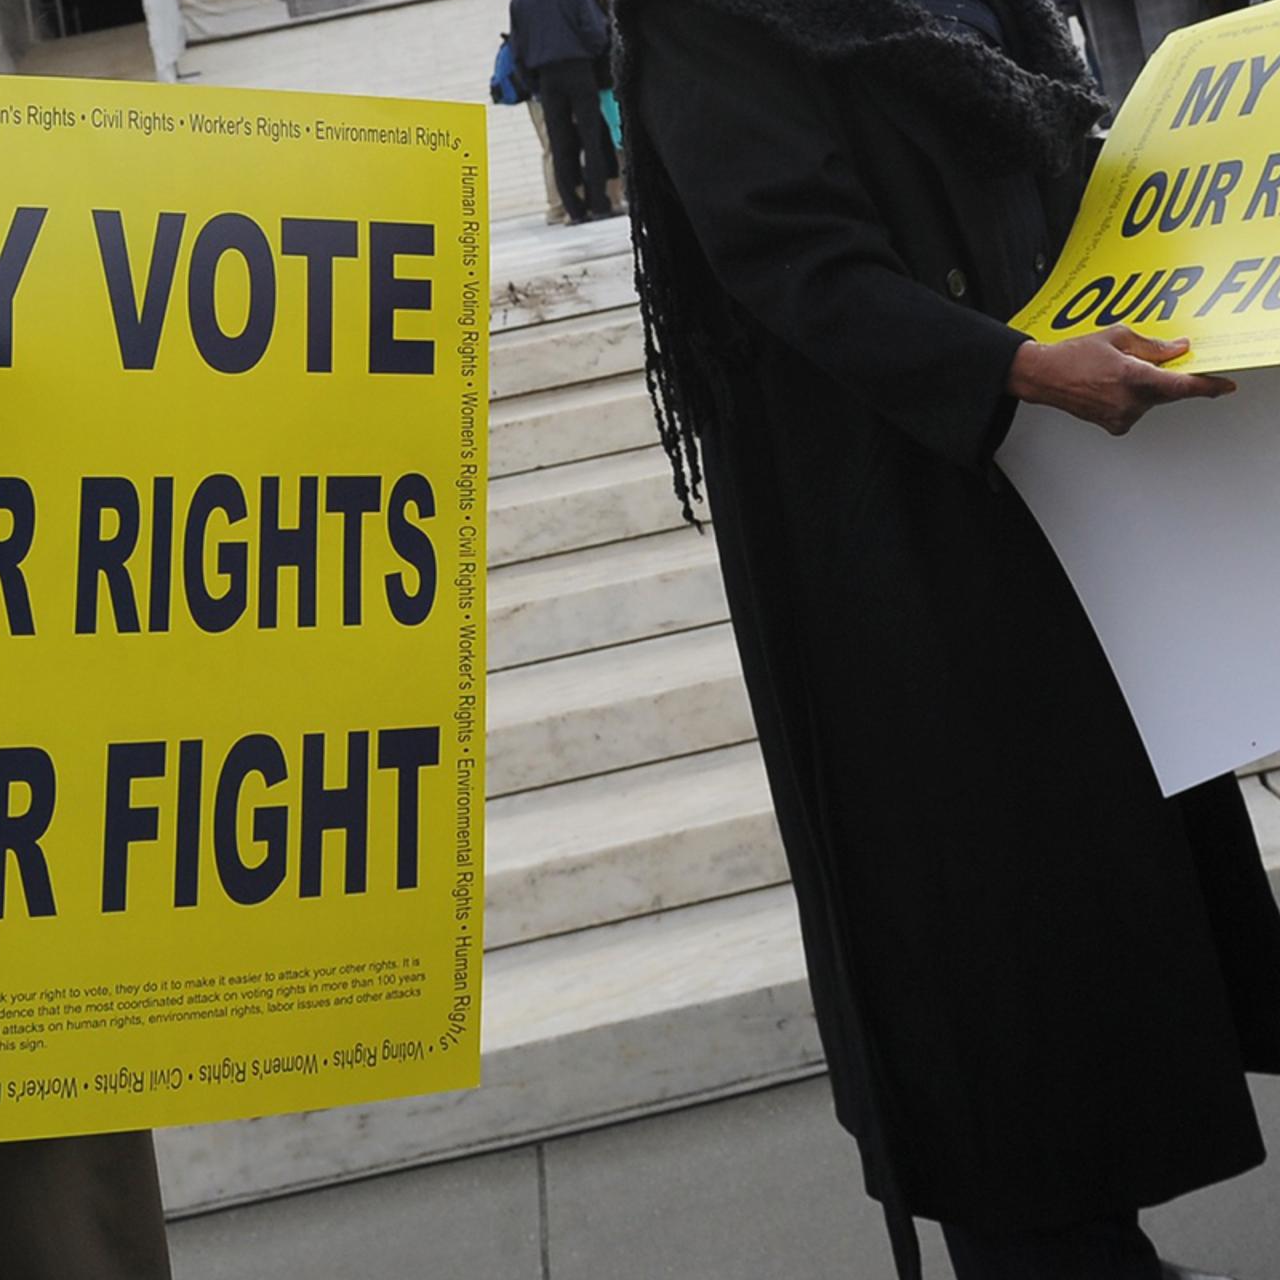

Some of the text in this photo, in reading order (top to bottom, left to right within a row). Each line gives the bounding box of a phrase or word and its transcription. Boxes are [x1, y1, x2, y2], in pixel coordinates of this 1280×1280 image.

[27, 104, 76, 131] Rights
[90, 107, 123, 129] Civil
[127, 109, 175, 136] Rights
[189, 113, 252, 136] Worker's
[256, 116, 301, 143] Rights
[315, 120, 412, 145] Environmental
[415, 126, 461, 152] Rights
[1120, 158, 1245, 238] OUR
[91, 208, 436, 376] VOTE
[1050, 266, 1204, 329] OUR
[74, 472, 438, 635] RIGHTS
[439, 165, 480, 1051] Human Rights Voting Rights Women's Rights Civil Rights Worker's Rights Environmental Rights Human Rights
[100, 726, 441, 914] FIGHT
[1, 1022, 45, 1035] attacks
[47, 1021, 64, 1032] on
[66, 1018, 107, 1031] human
[148, 1006, 228, 1024] environmental
[267, 1001, 295, 1013] labor
[296, 998, 331, 1010] issues
[333, 994, 354, 1006] and
[355, 991, 383, 1004] other
[384, 987, 421, 1000] attacks
[37, 1004, 60, 1017] that
[63, 1004, 82, 1015] the
[85, 1000, 114, 1013] most
[116, 994, 184, 1011] coordinated
[186, 991, 221, 1005] attack
[223, 991, 238, 1002] on
[240, 988, 274, 1000] voting
[276, 984, 306, 998] rights
[308, 982, 319, 993] in
[320, 980, 349, 992] more
[350, 977, 374, 989] than
[377, 973, 396, 986] 100
[398, 972, 426, 986] years
[198, 1056, 247, 1085] Rights
[251, 1053, 318, 1080] Women's
[333, 1042, 377, 1069] Rights
[381, 1038, 424, 1063] Voting
[7, 1077, 78, 1103] Worker's
[94, 1066, 145, 1094] Rights
[149, 1067, 183, 1091] Civil
